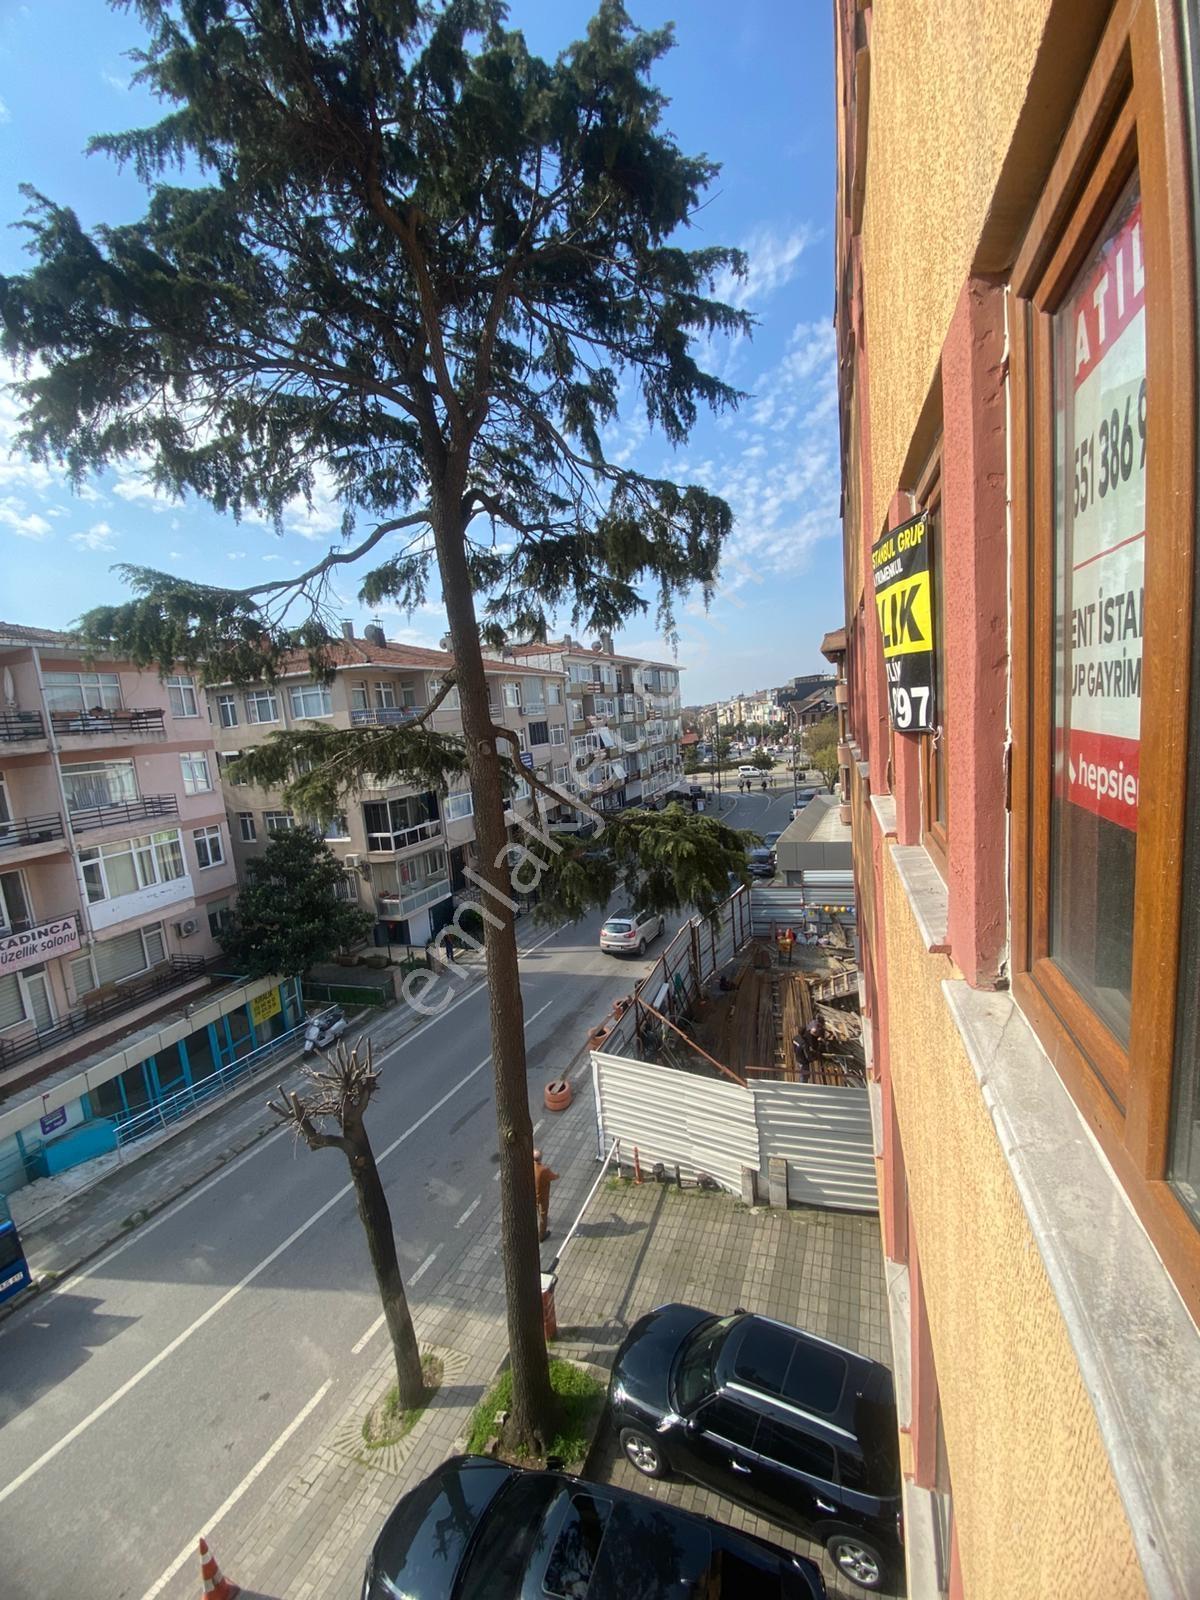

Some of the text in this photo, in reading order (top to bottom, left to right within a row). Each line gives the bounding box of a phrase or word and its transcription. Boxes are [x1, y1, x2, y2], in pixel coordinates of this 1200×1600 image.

[1075, 221, 1145, 377] ATIL
[1098, 395, 1134, 499] 386
[897, 521, 925, 553] GRUP
[881, 583, 925, 649] LIK
[1079, 753, 1139, 807] hepsie
[0, 931, 77, 965] üzellik salonu
